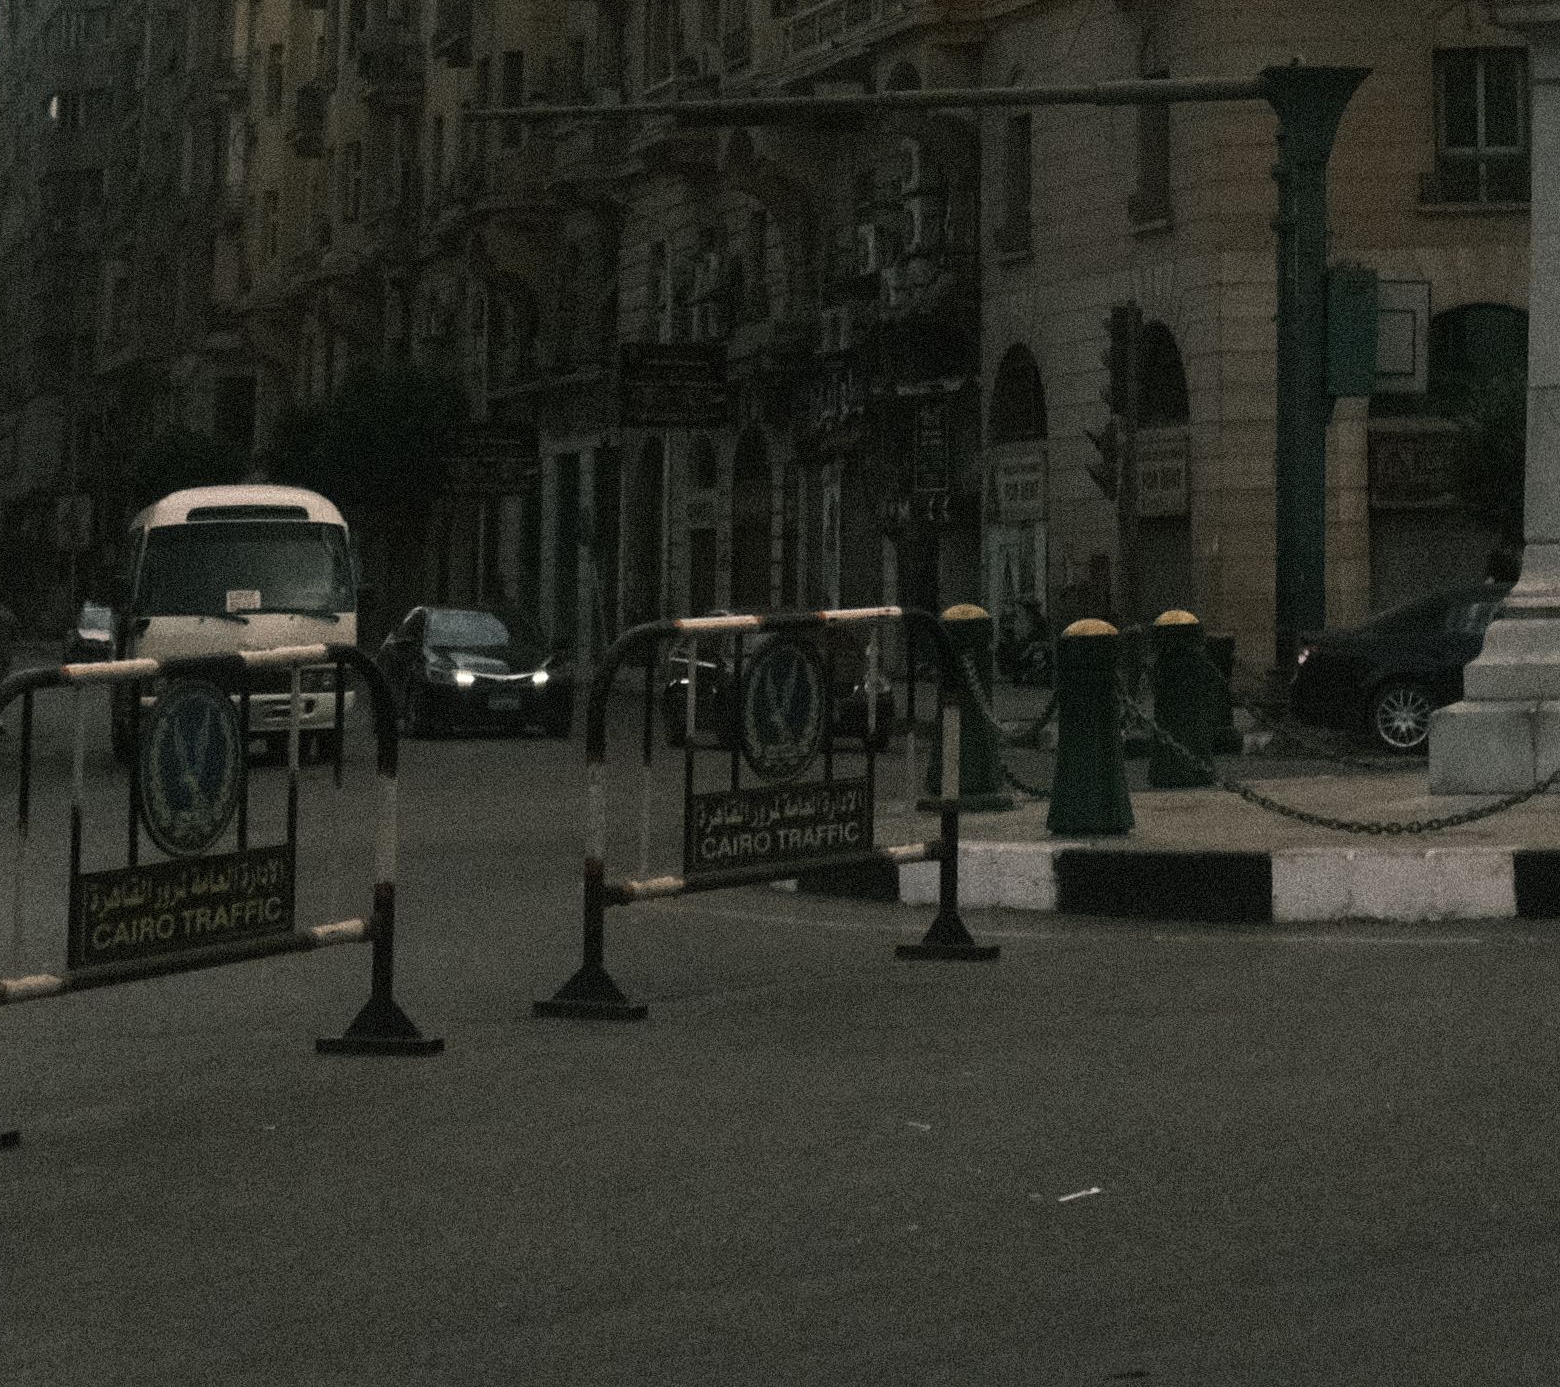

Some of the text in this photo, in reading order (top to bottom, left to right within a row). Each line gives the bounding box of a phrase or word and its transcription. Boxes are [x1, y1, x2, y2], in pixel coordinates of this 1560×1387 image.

[700, 820, 861, 861] CAIRO TRAFFIC
[91, 895, 283, 951] CAIRO TRAFFIC
